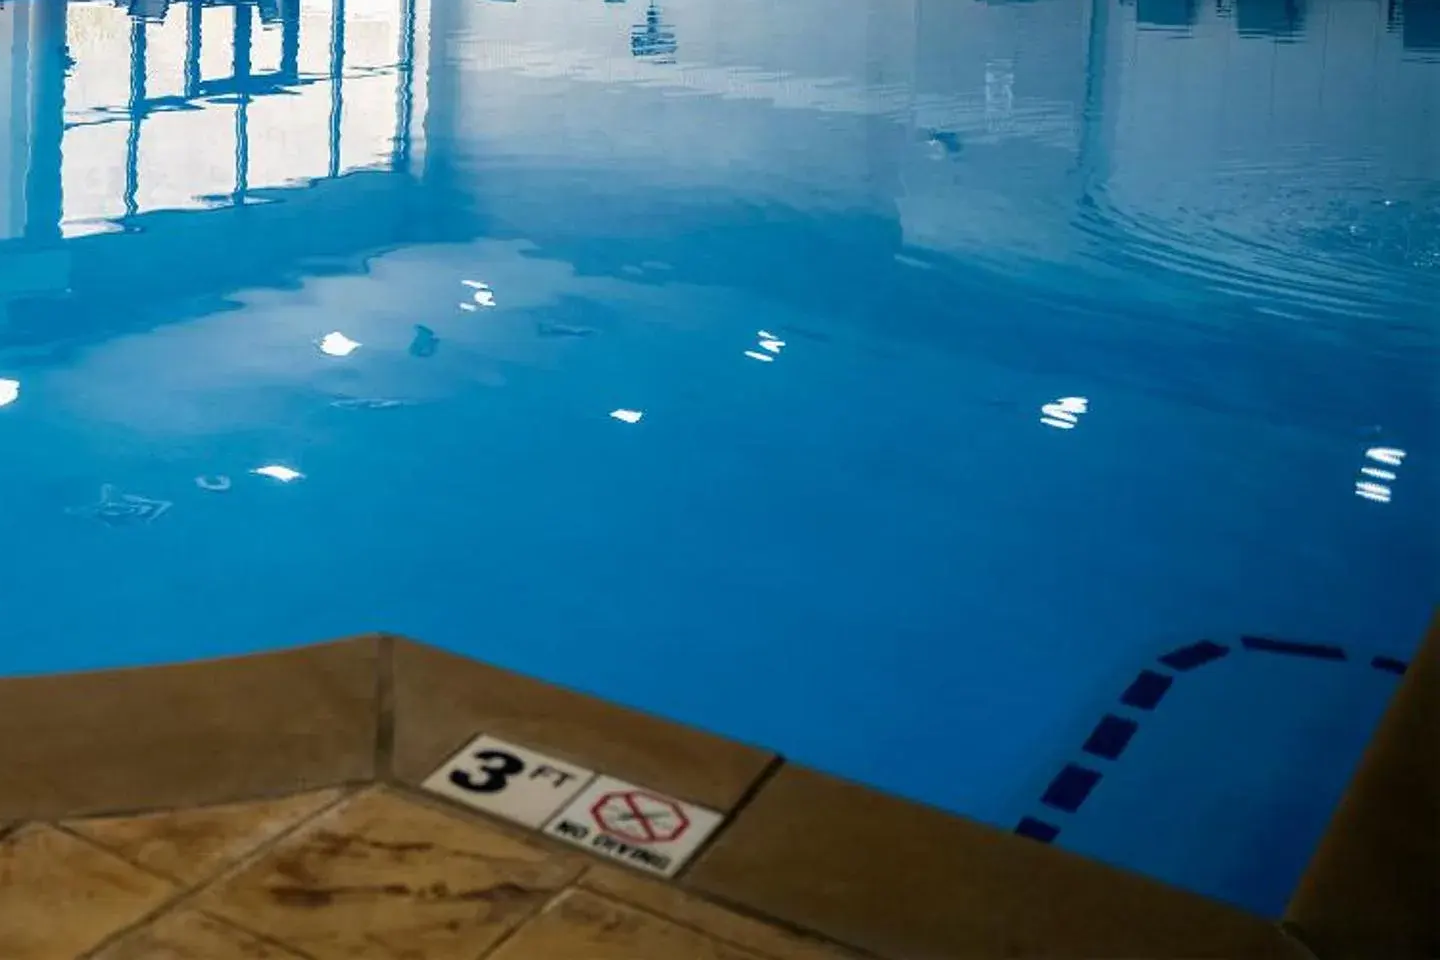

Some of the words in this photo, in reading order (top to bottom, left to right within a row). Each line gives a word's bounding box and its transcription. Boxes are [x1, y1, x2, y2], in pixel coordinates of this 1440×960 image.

[449, 749, 525, 793] 3
[530, 765, 576, 788] FT
[556, 820, 589, 841] NO
[593, 836, 671, 869] DIVING
